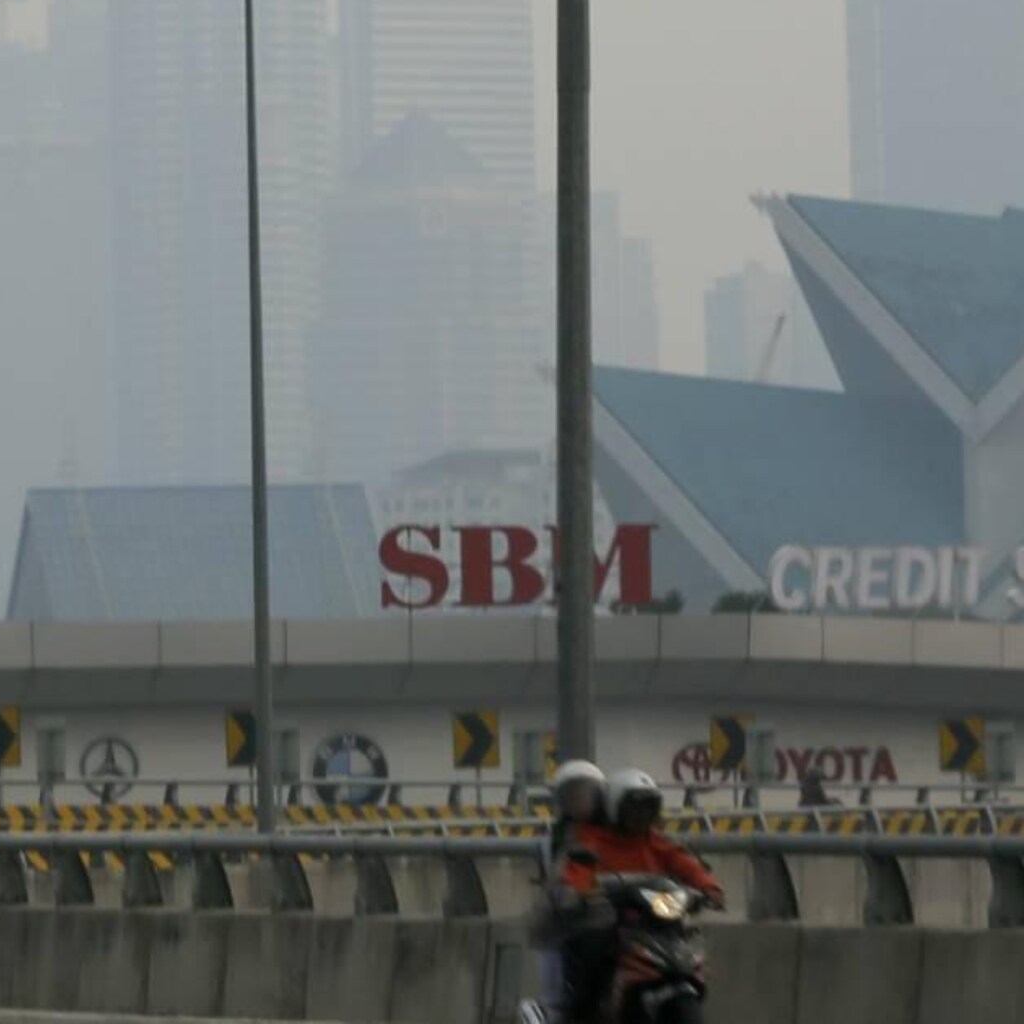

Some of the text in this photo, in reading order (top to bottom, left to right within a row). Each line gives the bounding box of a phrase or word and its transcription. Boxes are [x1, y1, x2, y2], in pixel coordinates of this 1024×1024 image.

[378, 524, 659, 609] SBM
[769, 543, 990, 610] CREDIT
[740, 746, 898, 783] YOTA
